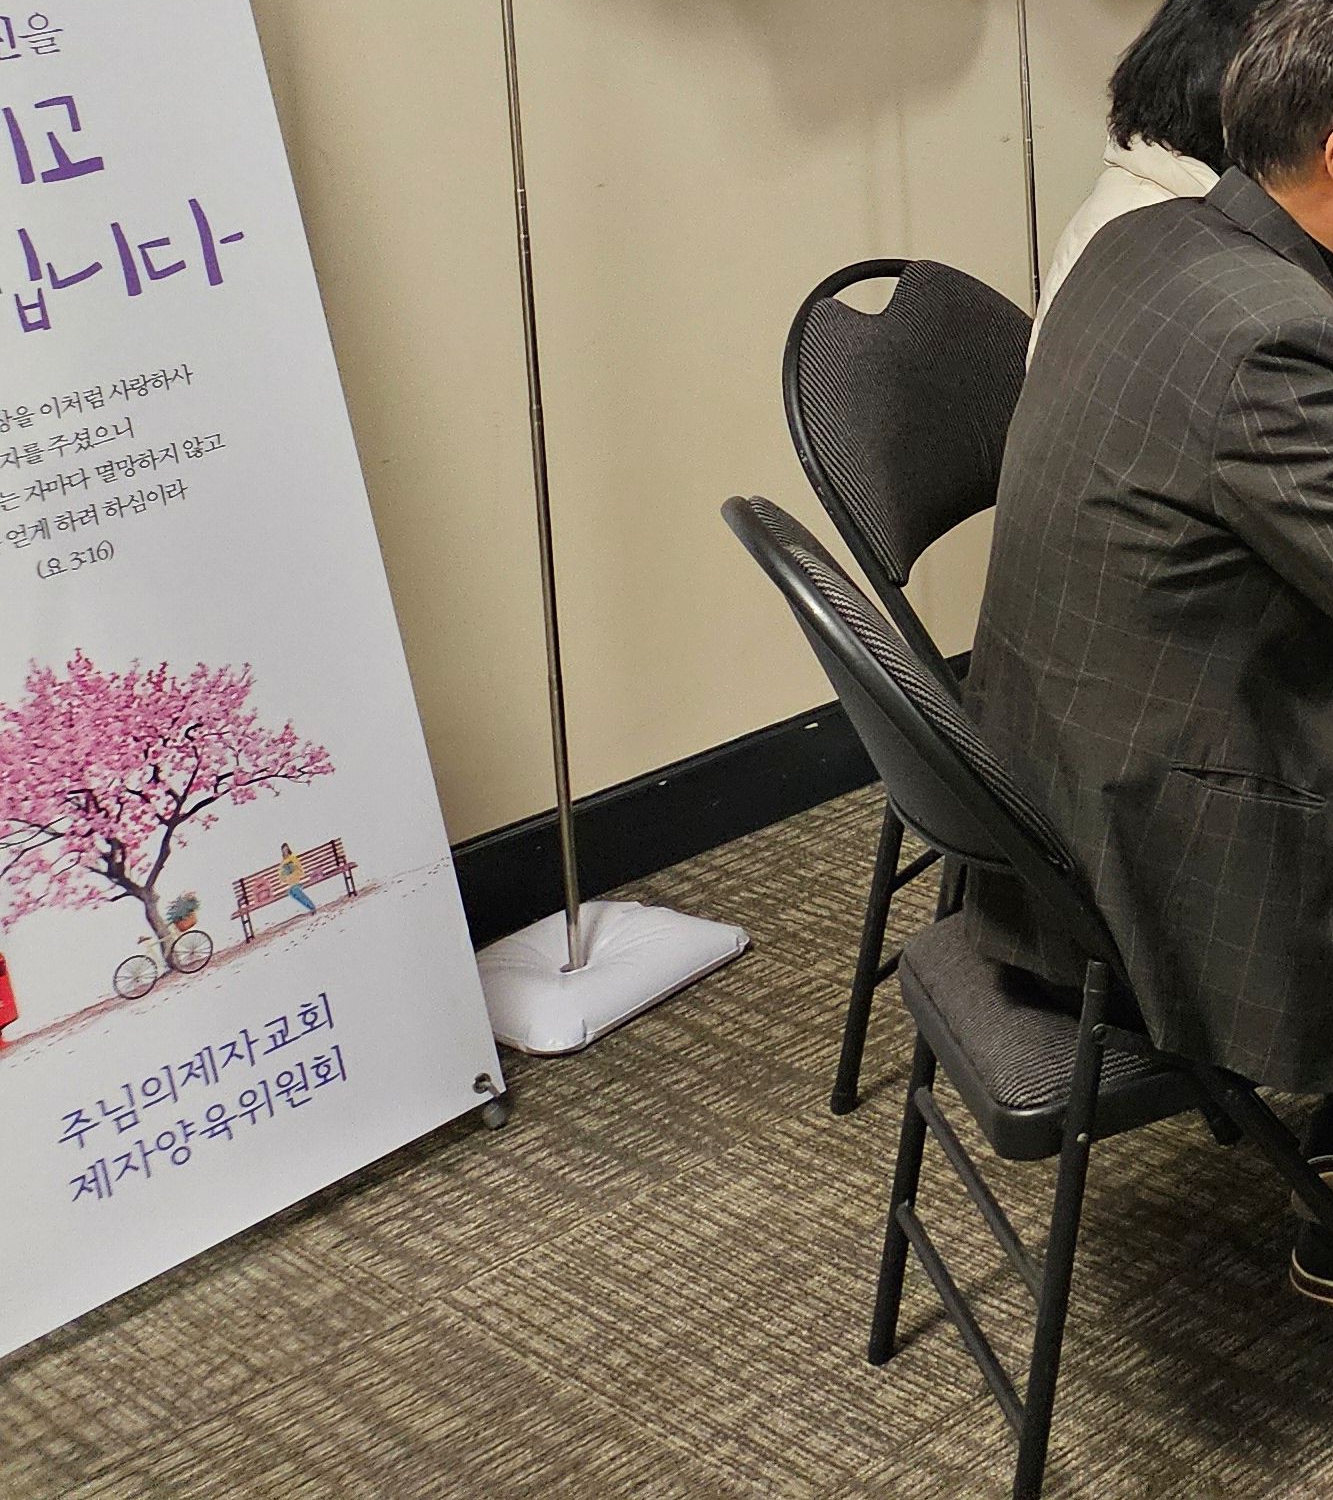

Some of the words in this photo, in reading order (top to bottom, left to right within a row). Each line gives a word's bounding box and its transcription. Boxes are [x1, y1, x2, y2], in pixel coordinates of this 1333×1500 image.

[40, 385, 105, 419] 이처럼
[109, 363, 194, 401] 사랑하사
[24, 468, 91, 502] 자마다
[95, 442, 180, 484] 멸망하지
[182, 433, 226, 459] 않고
[48, 416, 134, 457] 주셨으니
[6, 517, 52, 548] 얻게
[54, 503, 100, 532] 하려
[102, 479, 188, 518] 하심이라
